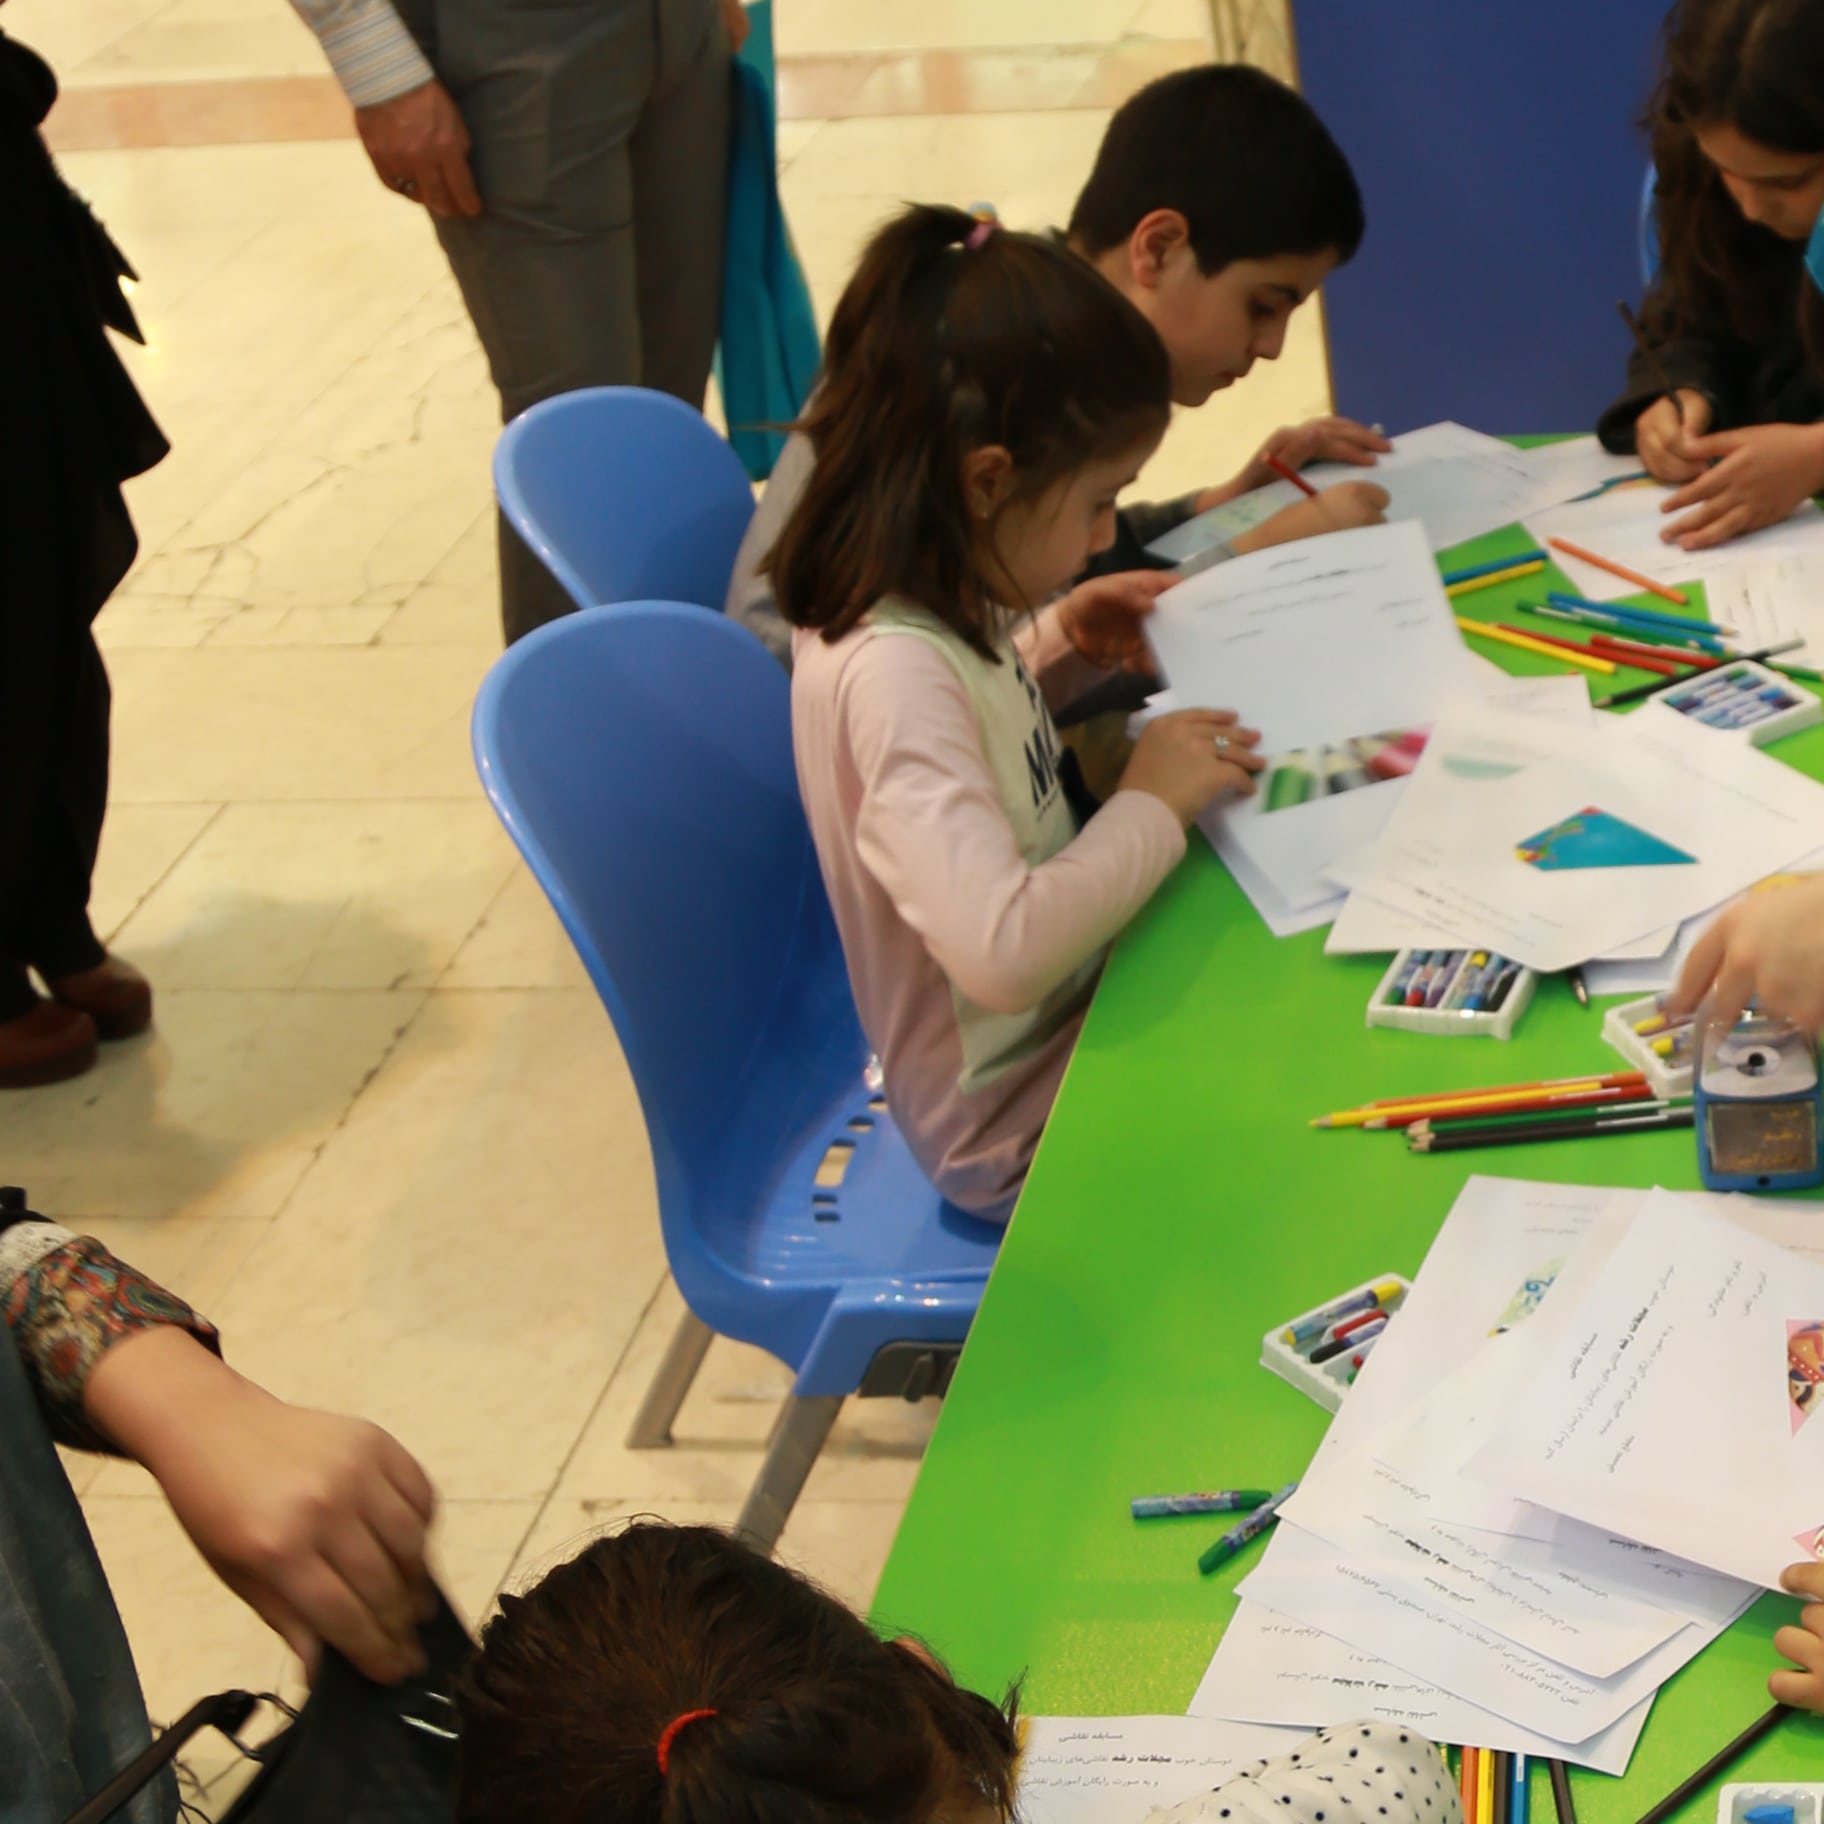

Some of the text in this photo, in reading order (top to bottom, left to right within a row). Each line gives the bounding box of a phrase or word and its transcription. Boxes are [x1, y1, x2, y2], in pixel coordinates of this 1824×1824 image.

[1629, 1306, 1649, 1333] مجلات
[1618, 1333, 1634, 1350] رشد
[1404, 1538, 1431, 1555] مجلات
[1433, 1552, 1449, 1565] رشد
[1331, 1677, 1365, 1687] مجلات
[1367, 1679, 1389, 1690] رشد
[1372, 1705, 1438, 1720] مسابقه نقاشی
[1057, 1731, 1123, 1743] مسابقه نقاشی
[1111, 1754, 1134, 1764] رشد
[1136, 1753, 1172, 1763] مجلات
